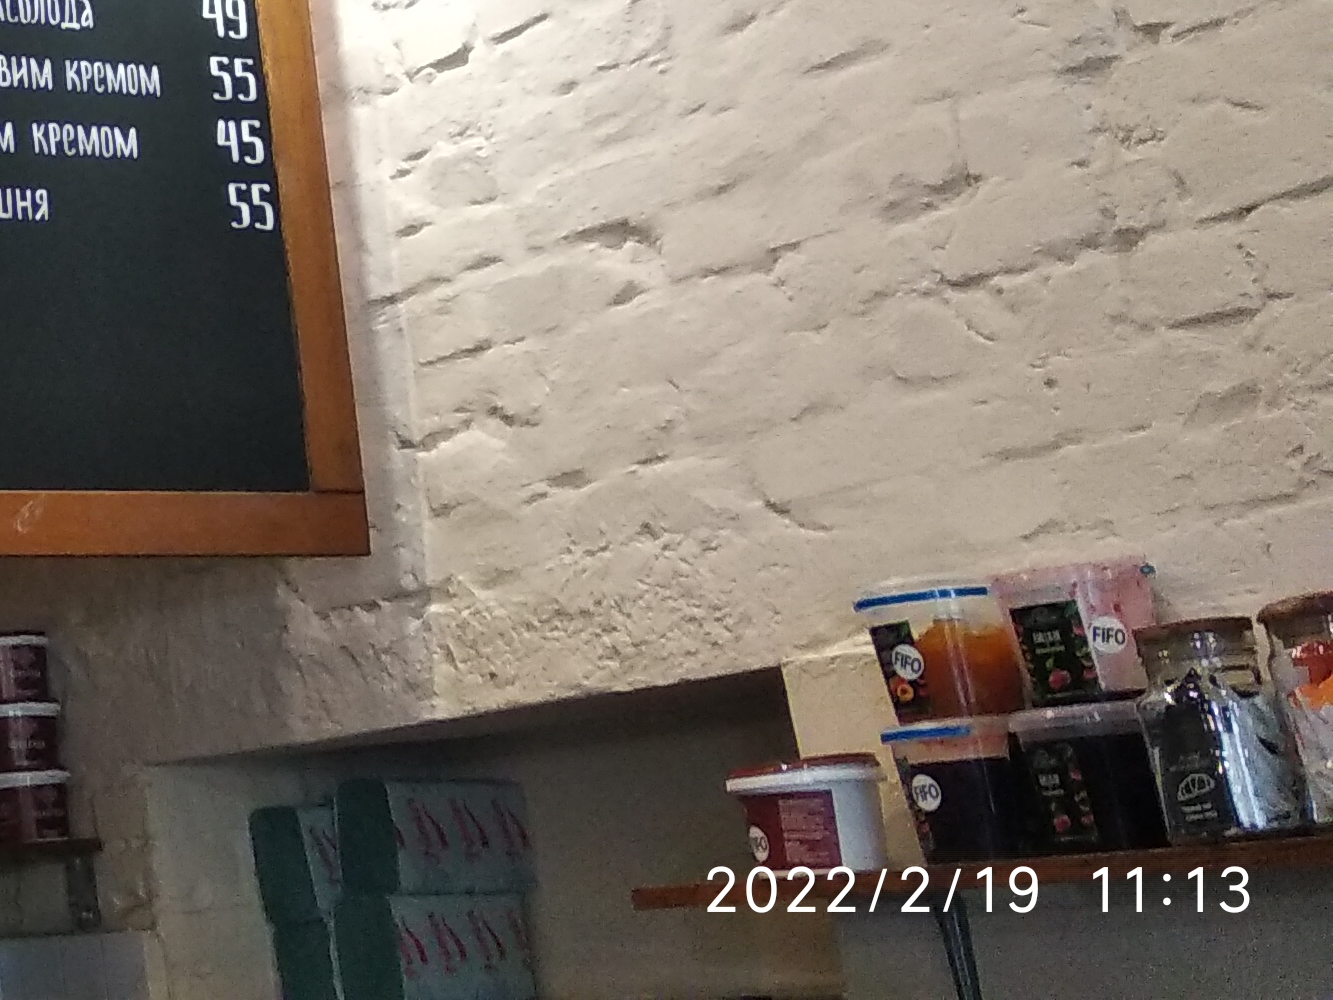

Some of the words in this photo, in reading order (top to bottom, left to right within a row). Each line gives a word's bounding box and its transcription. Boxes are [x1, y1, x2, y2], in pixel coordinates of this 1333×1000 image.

[65, 60, 160, 97] кремом
[210, 56, 257, 101] 55
[32, 123, 138, 159] кремом
[217, 119, 264, 164] 45
[228, 183, 274, 230] 55
[1093, 626, 1126, 646] FIFO
[894, 652, 922, 675] FIFO
